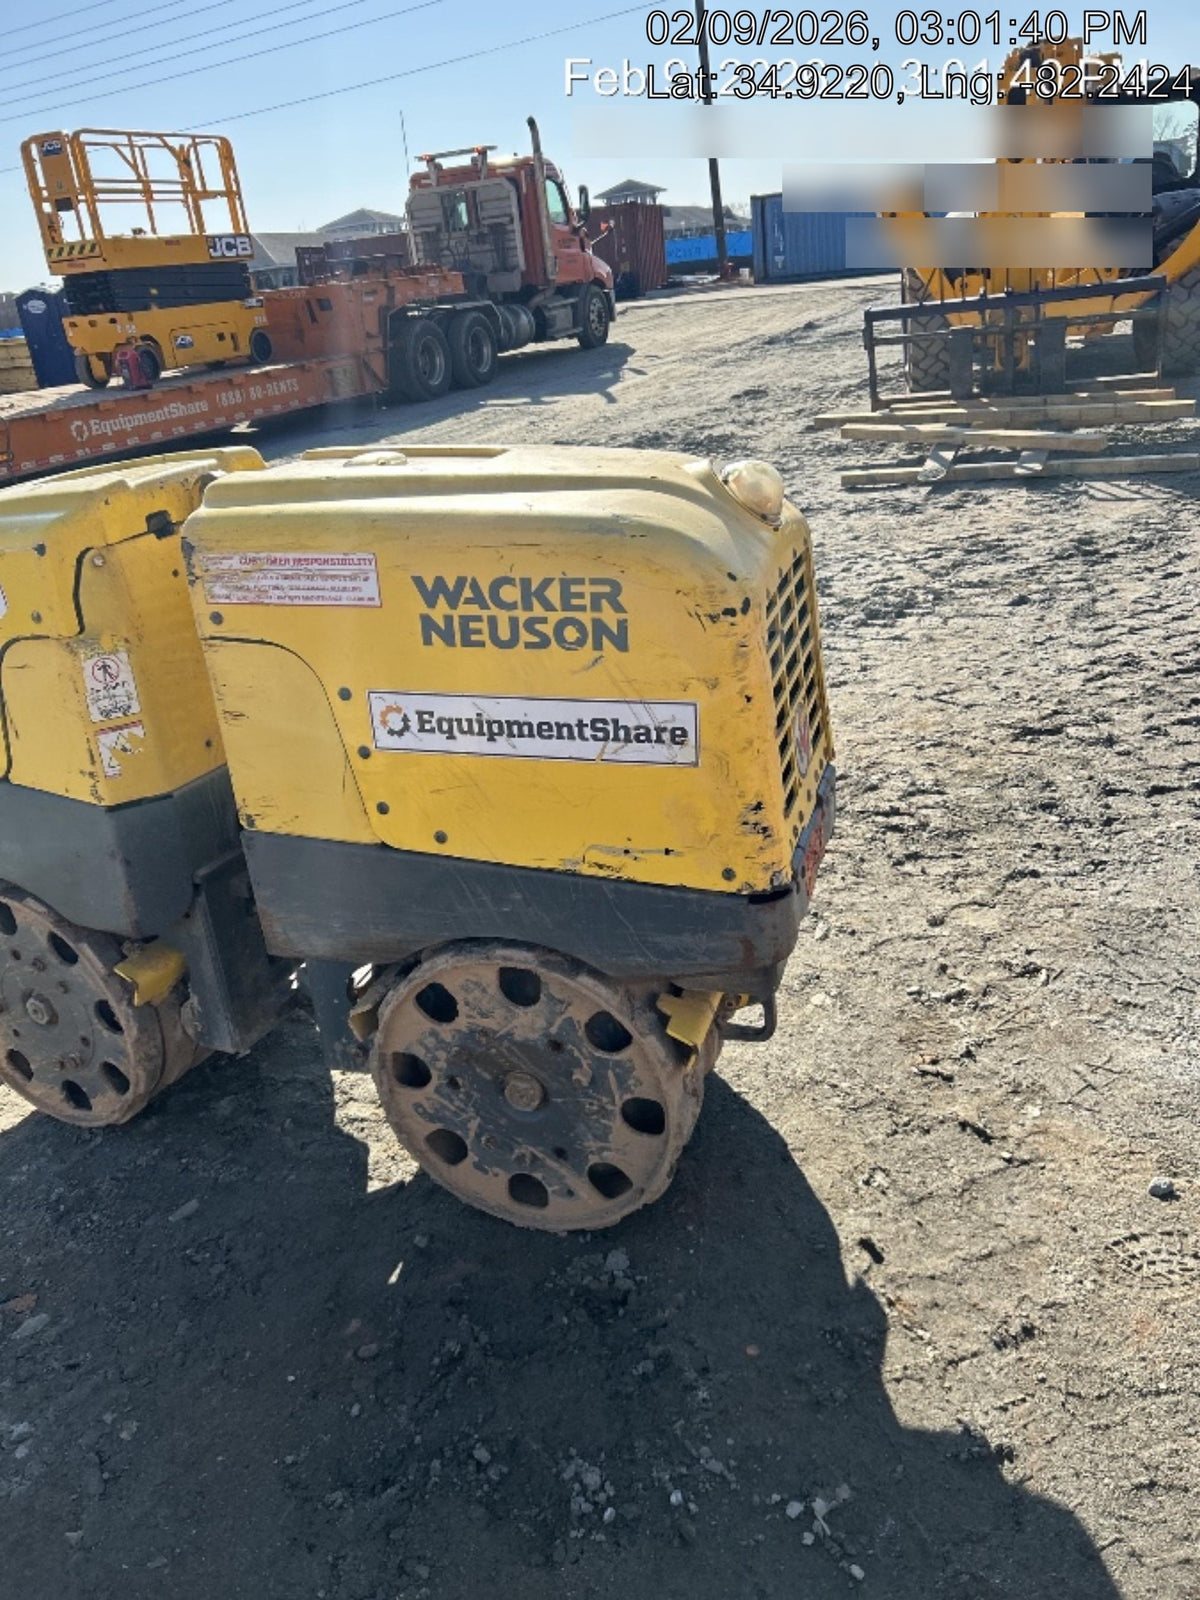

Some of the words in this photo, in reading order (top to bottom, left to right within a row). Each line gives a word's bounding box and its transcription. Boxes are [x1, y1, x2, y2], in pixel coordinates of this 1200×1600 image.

[209, 236, 252, 256] JCB
[89, 399, 209, 436] EquipmentShare
[239, 556, 290, 567] CUSOMER
[292, 556, 375, 567] RESPONSIBILITY
[411, 574, 628, 614] WACKER
[420, 613, 630, 653] NEUSON
[416, 709, 689, 746] EquipmentShare
